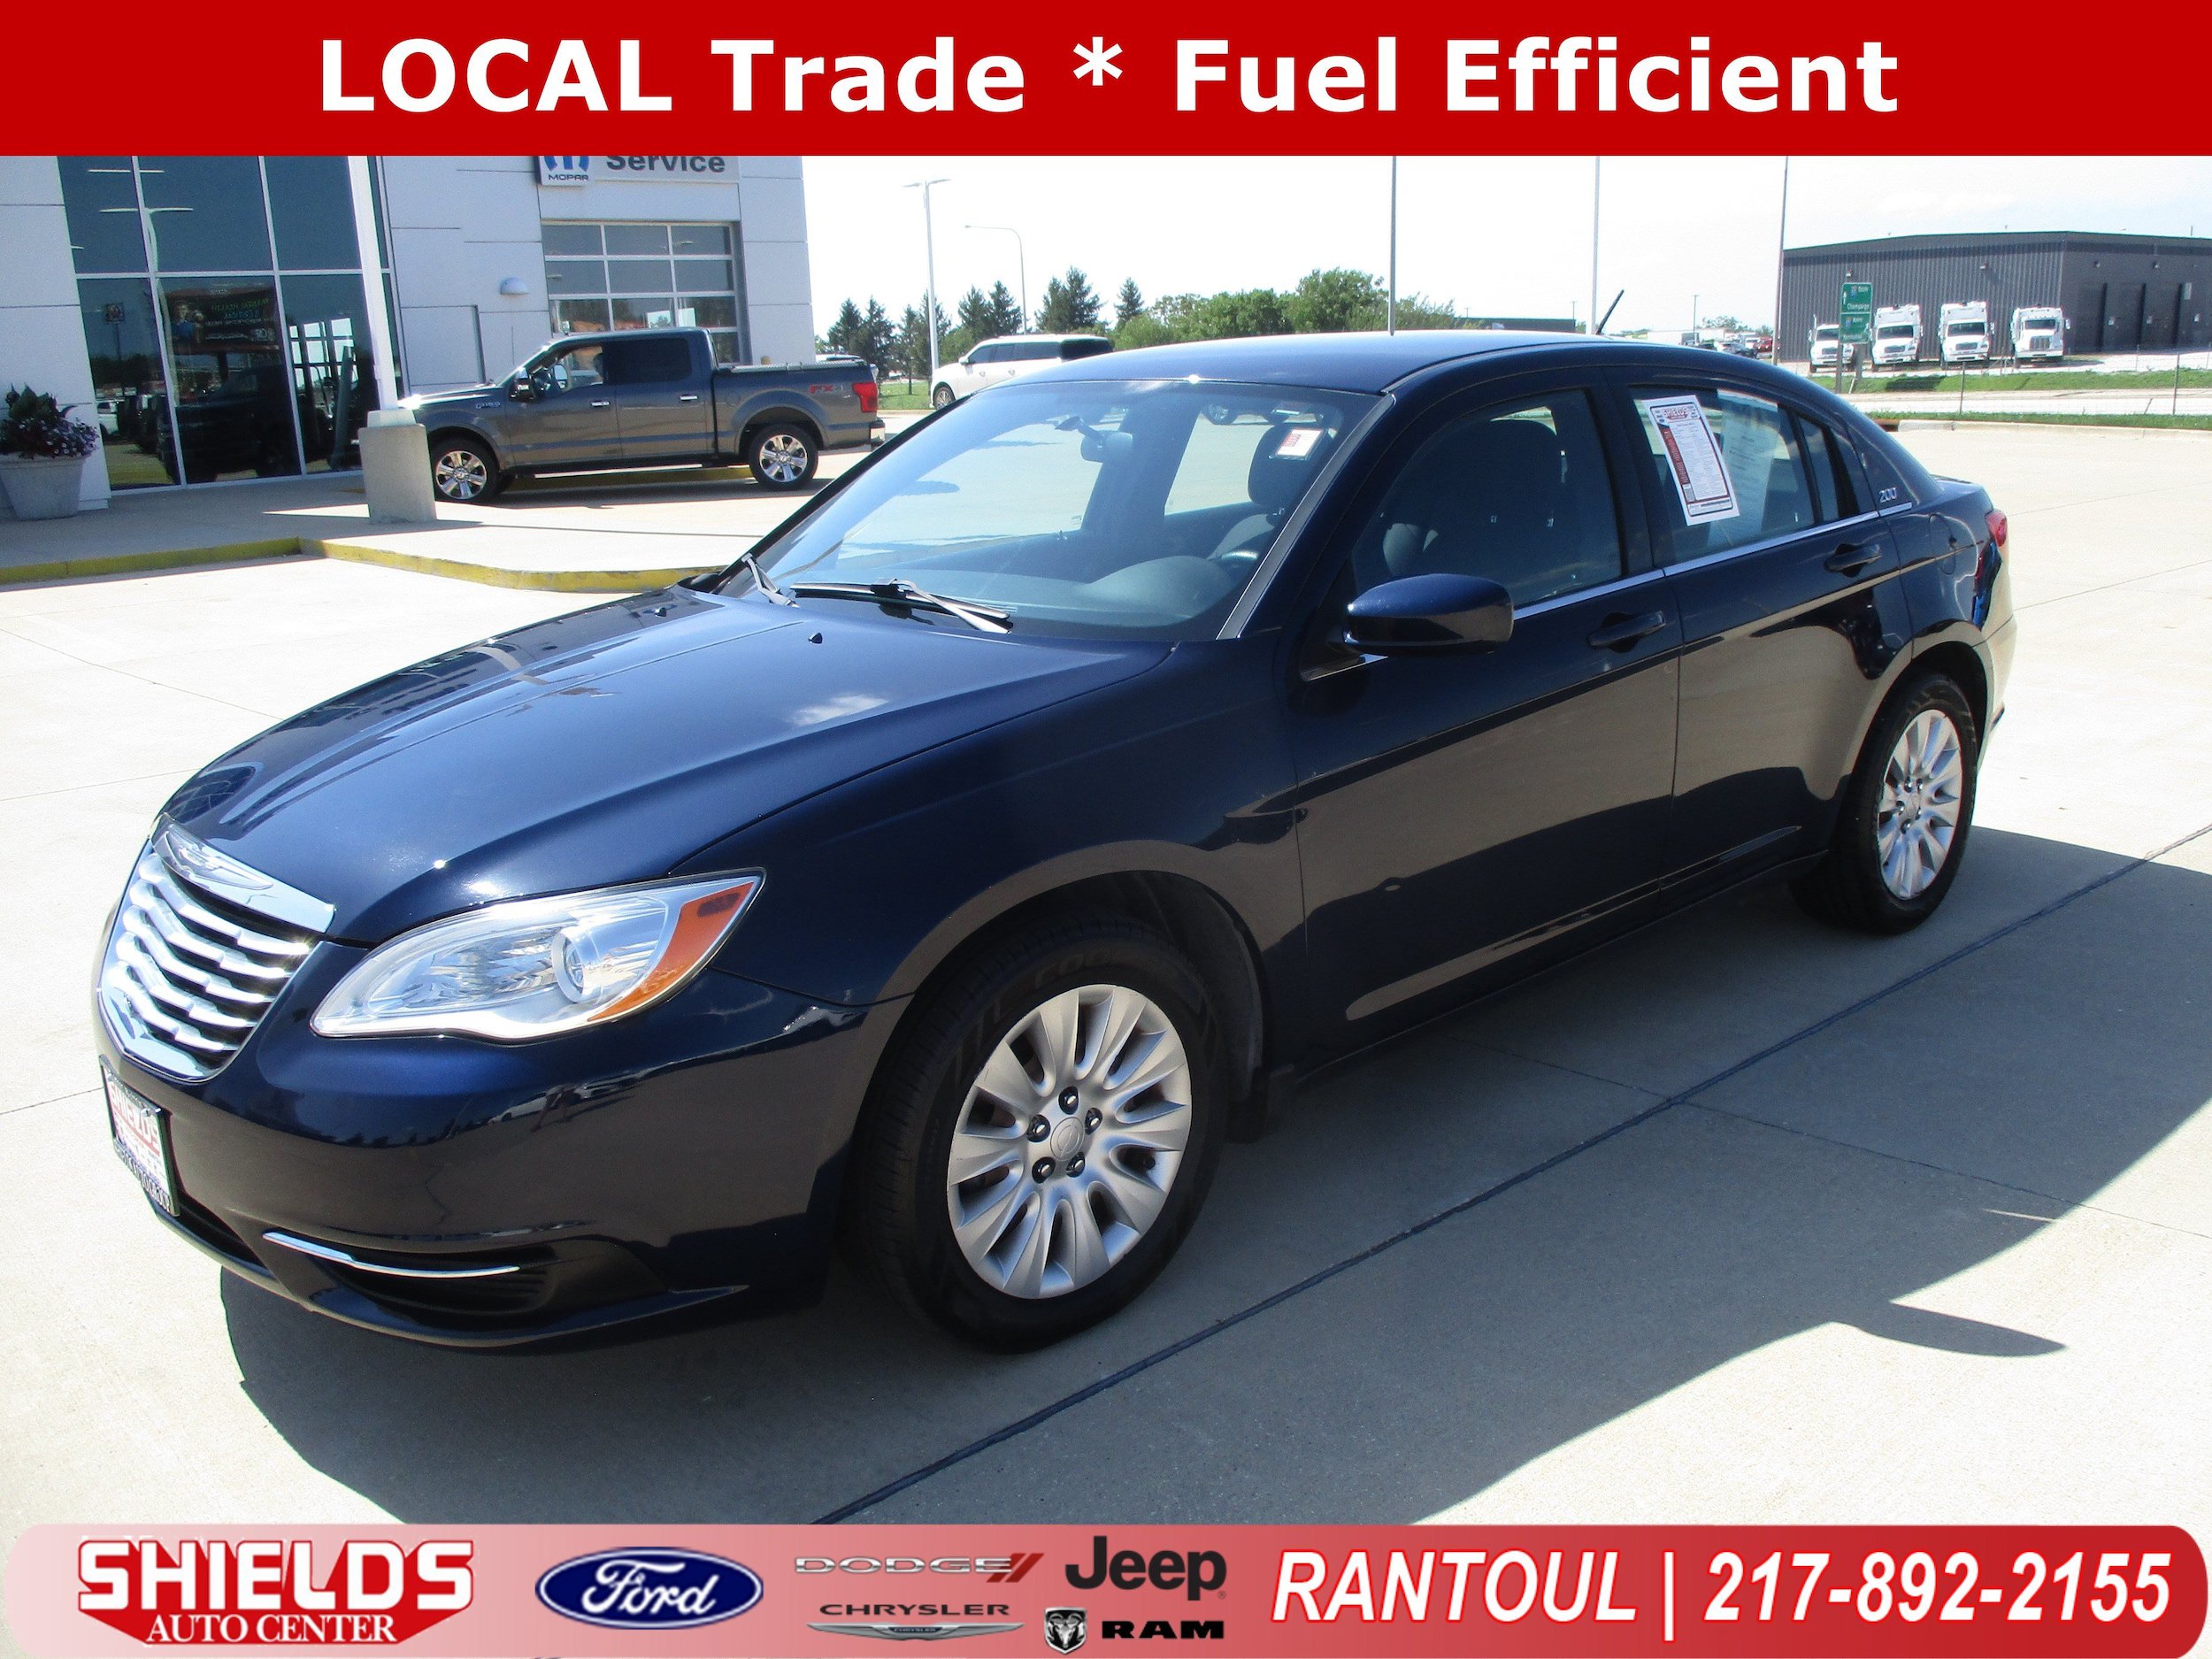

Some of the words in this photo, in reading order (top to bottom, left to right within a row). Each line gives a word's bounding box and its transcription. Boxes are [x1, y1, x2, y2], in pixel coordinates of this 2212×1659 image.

[606, 156, 726, 173] Service
[548, 173, 589, 182] MOPAR
[1878, 486, 1897, 503] 200
